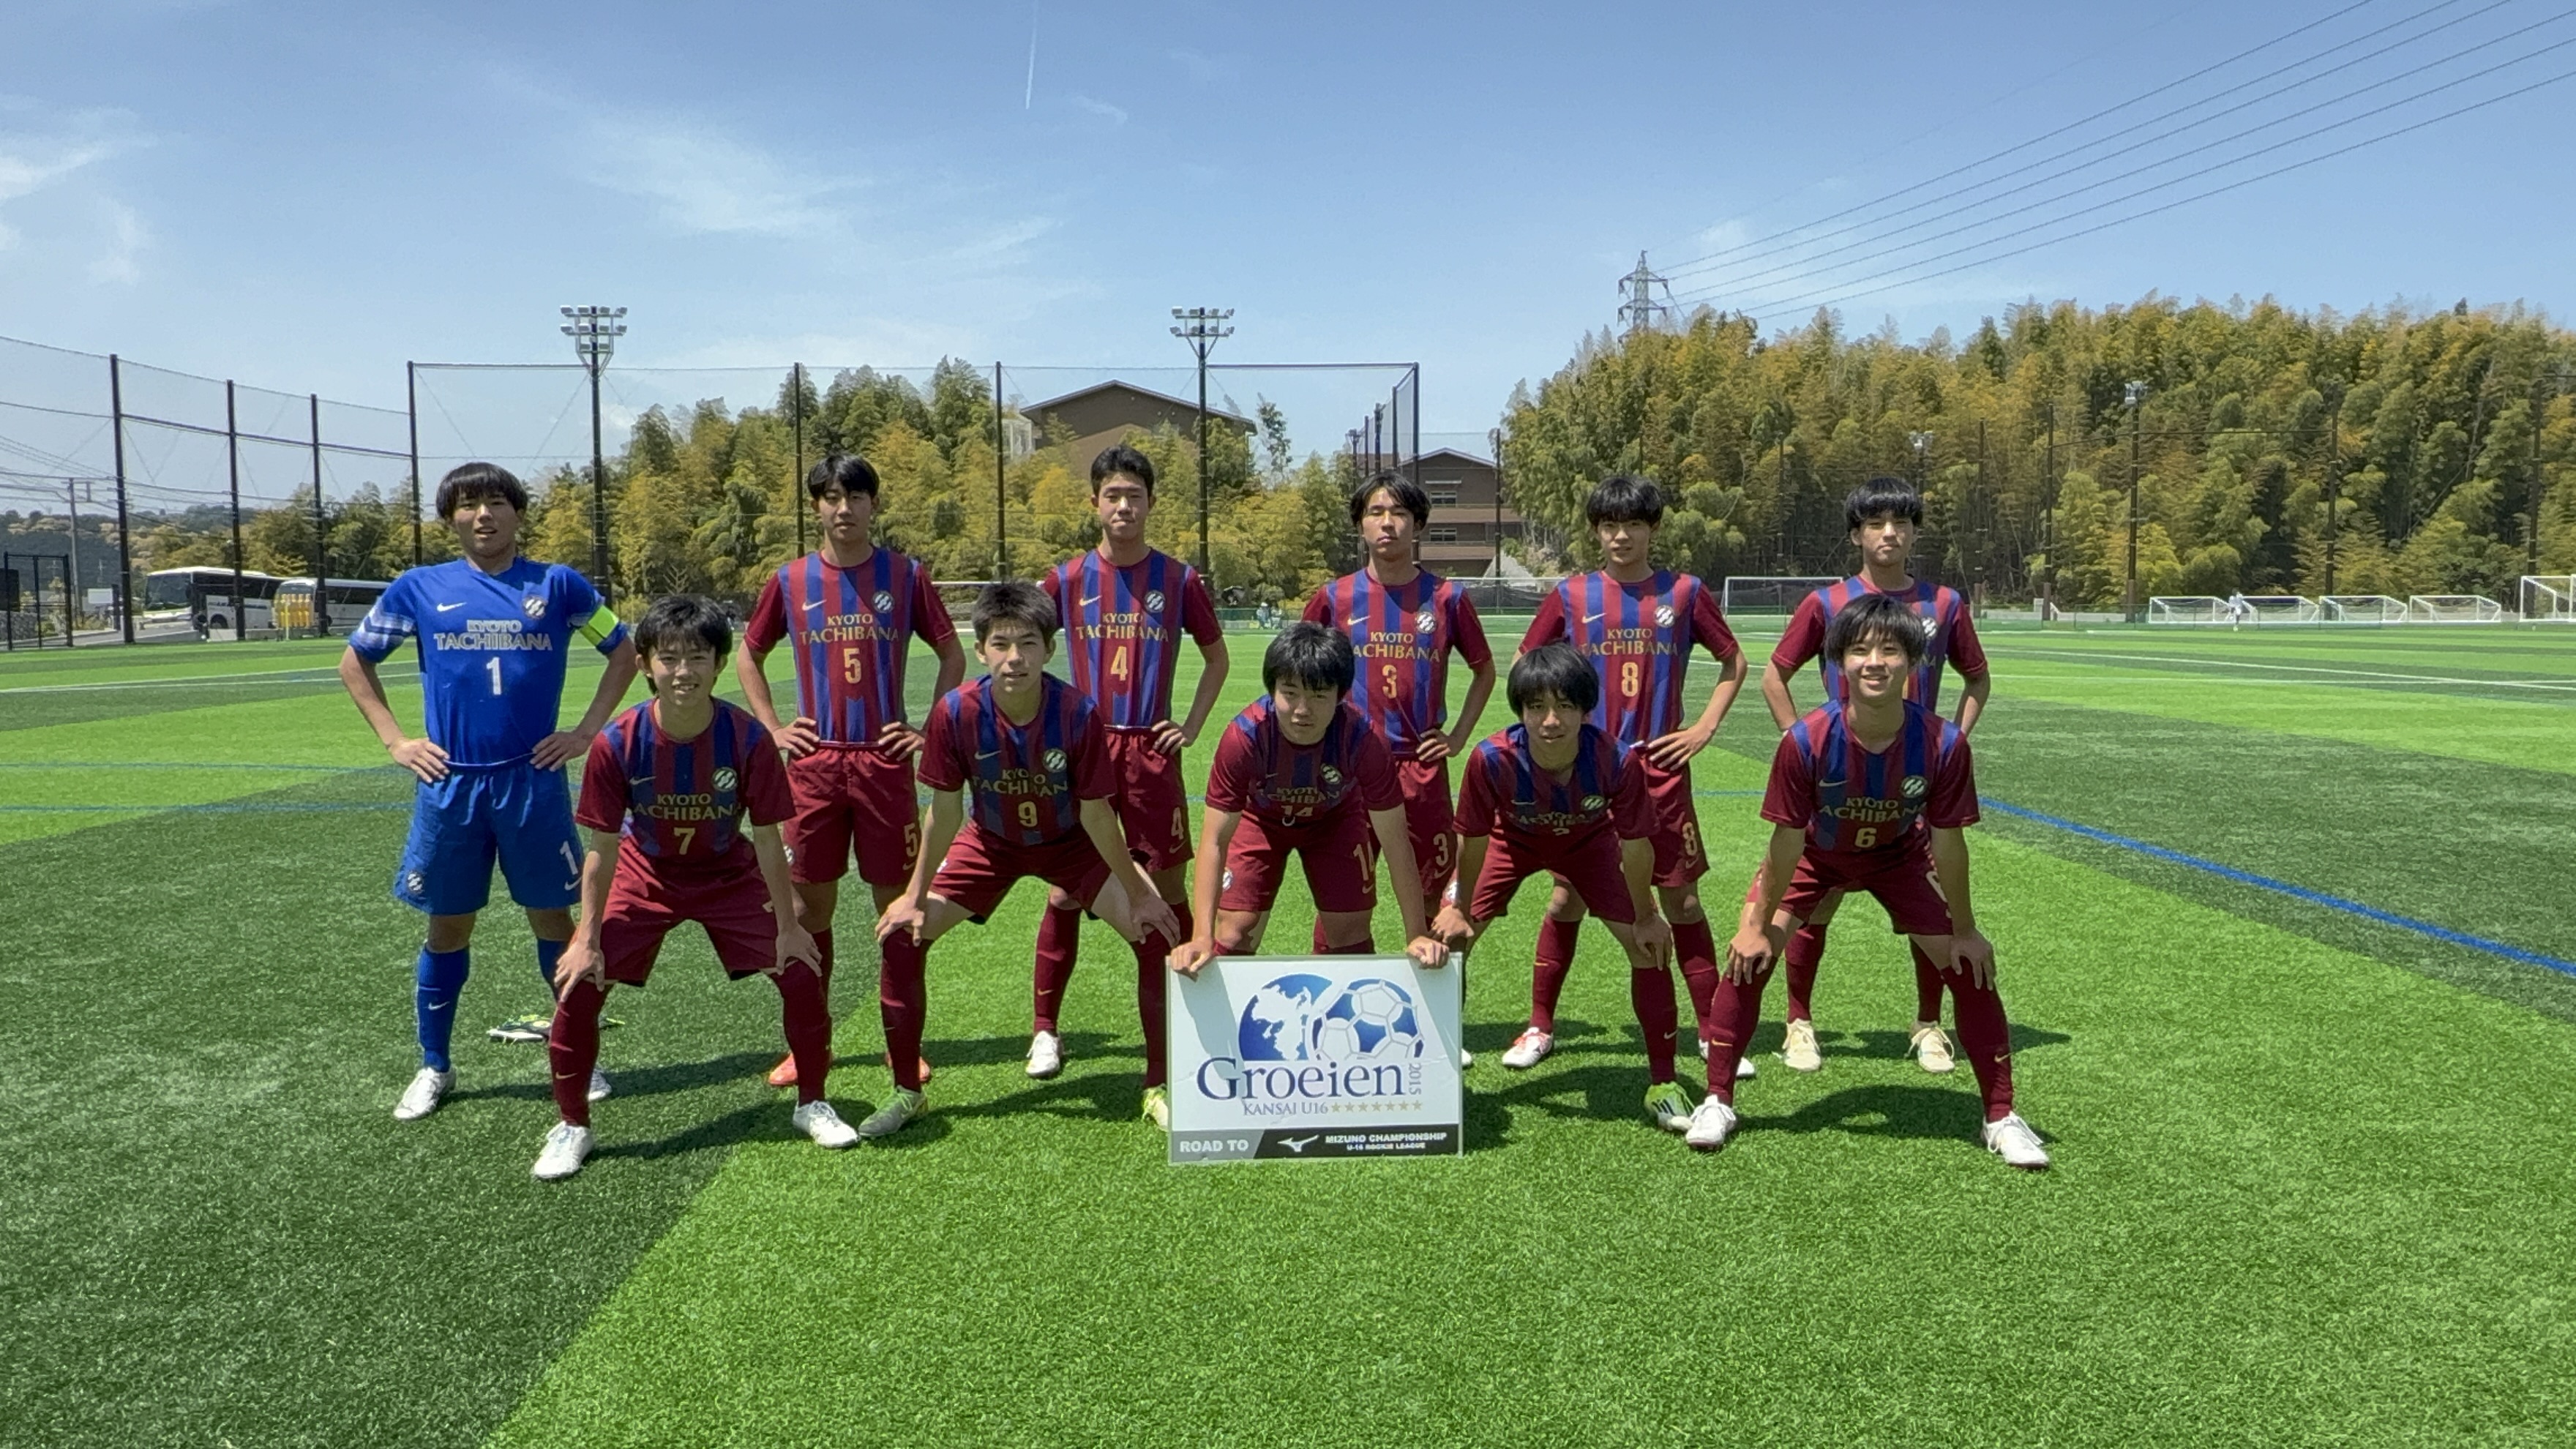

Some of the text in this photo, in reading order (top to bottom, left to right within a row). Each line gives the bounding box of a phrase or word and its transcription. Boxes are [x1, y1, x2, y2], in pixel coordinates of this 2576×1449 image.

[467, 619, 523, 632] KYOTO
[827, 614, 872, 626] KYOTO
[433, 632, 553, 651] TACHIBANA
[800, 626, 899, 645] TACHIBANA
[1076, 624, 1169, 642] TACHIBANA
[1370, 632, 1414, 643] KYOTO
[1608, 629, 1652, 639] KYOTO
[1353, 643, 1440, 662] ACHIBANA
[844, 648, 862, 684] 5
[1110, 645, 1128, 681] 4
[486, 656, 501, 695] 1
[1382, 664, 1397, 699] 3
[1621, 662, 1639, 697] 8
[1002, 768, 1046, 785] KYOO
[657, 793, 711, 805] KYOTO
[1846, 796, 1899, 809] KYOTO
[633, 802, 741, 821] ACHIBAN
[1018, 801, 1038, 827] 9
[1819, 801, 1927, 823] ACHIBAN
[1172, 806, 1184, 840] 4
[673, 827, 695, 855] 7
[904, 823, 918, 857] 5
[1682, 822, 1698, 855] 8
[1854, 826, 1877, 849] 6
[559, 840, 579, 875] 1
[1433, 833, 1448, 866] 3
[1197, 1057, 1407, 1100] Groeien
[1244, 1101, 1329, 1116] KANSAI U16
[1180, 1139, 1249, 1153] ROAD TO
[1325, 1132, 1448, 1143] MIZUNO CHAMPIONSHIP
